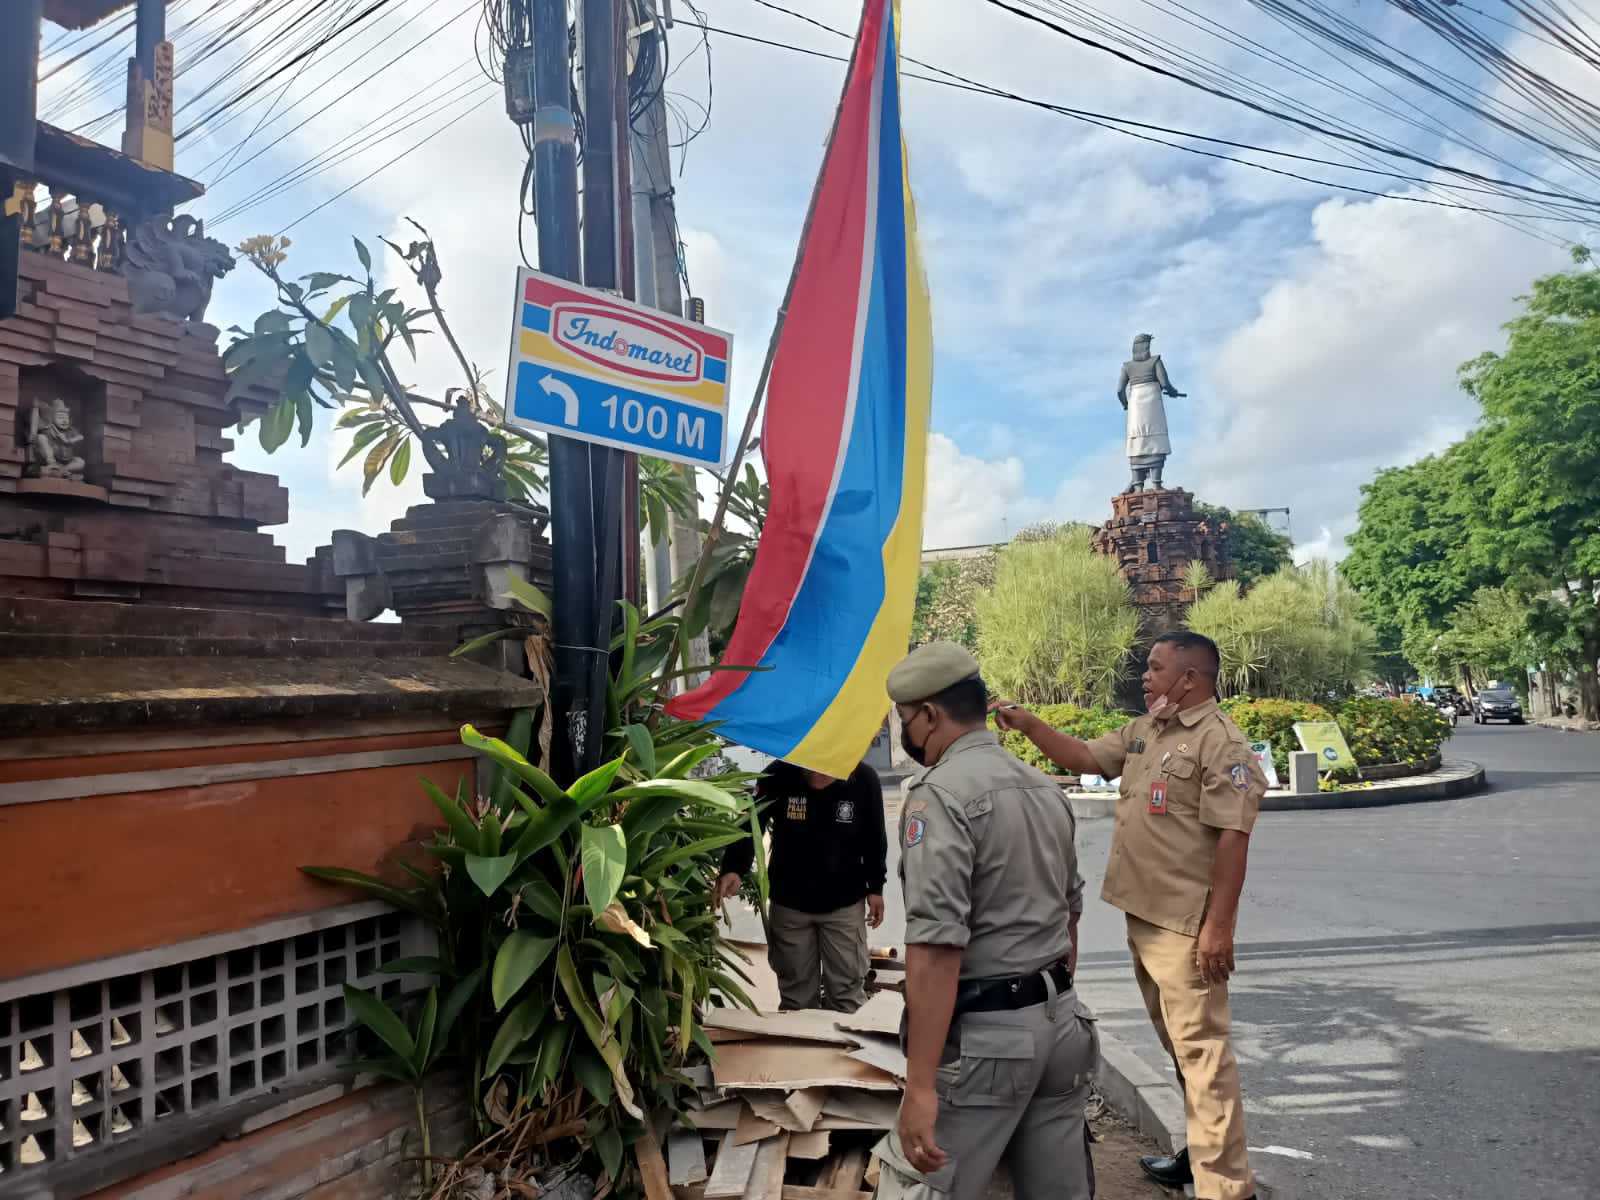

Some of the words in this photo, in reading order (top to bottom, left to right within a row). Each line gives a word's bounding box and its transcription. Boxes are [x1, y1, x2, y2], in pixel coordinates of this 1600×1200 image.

[563, 318, 693, 374] Indomaret
[601, 395, 668, 440] 100
[676, 412, 706, 451] M
